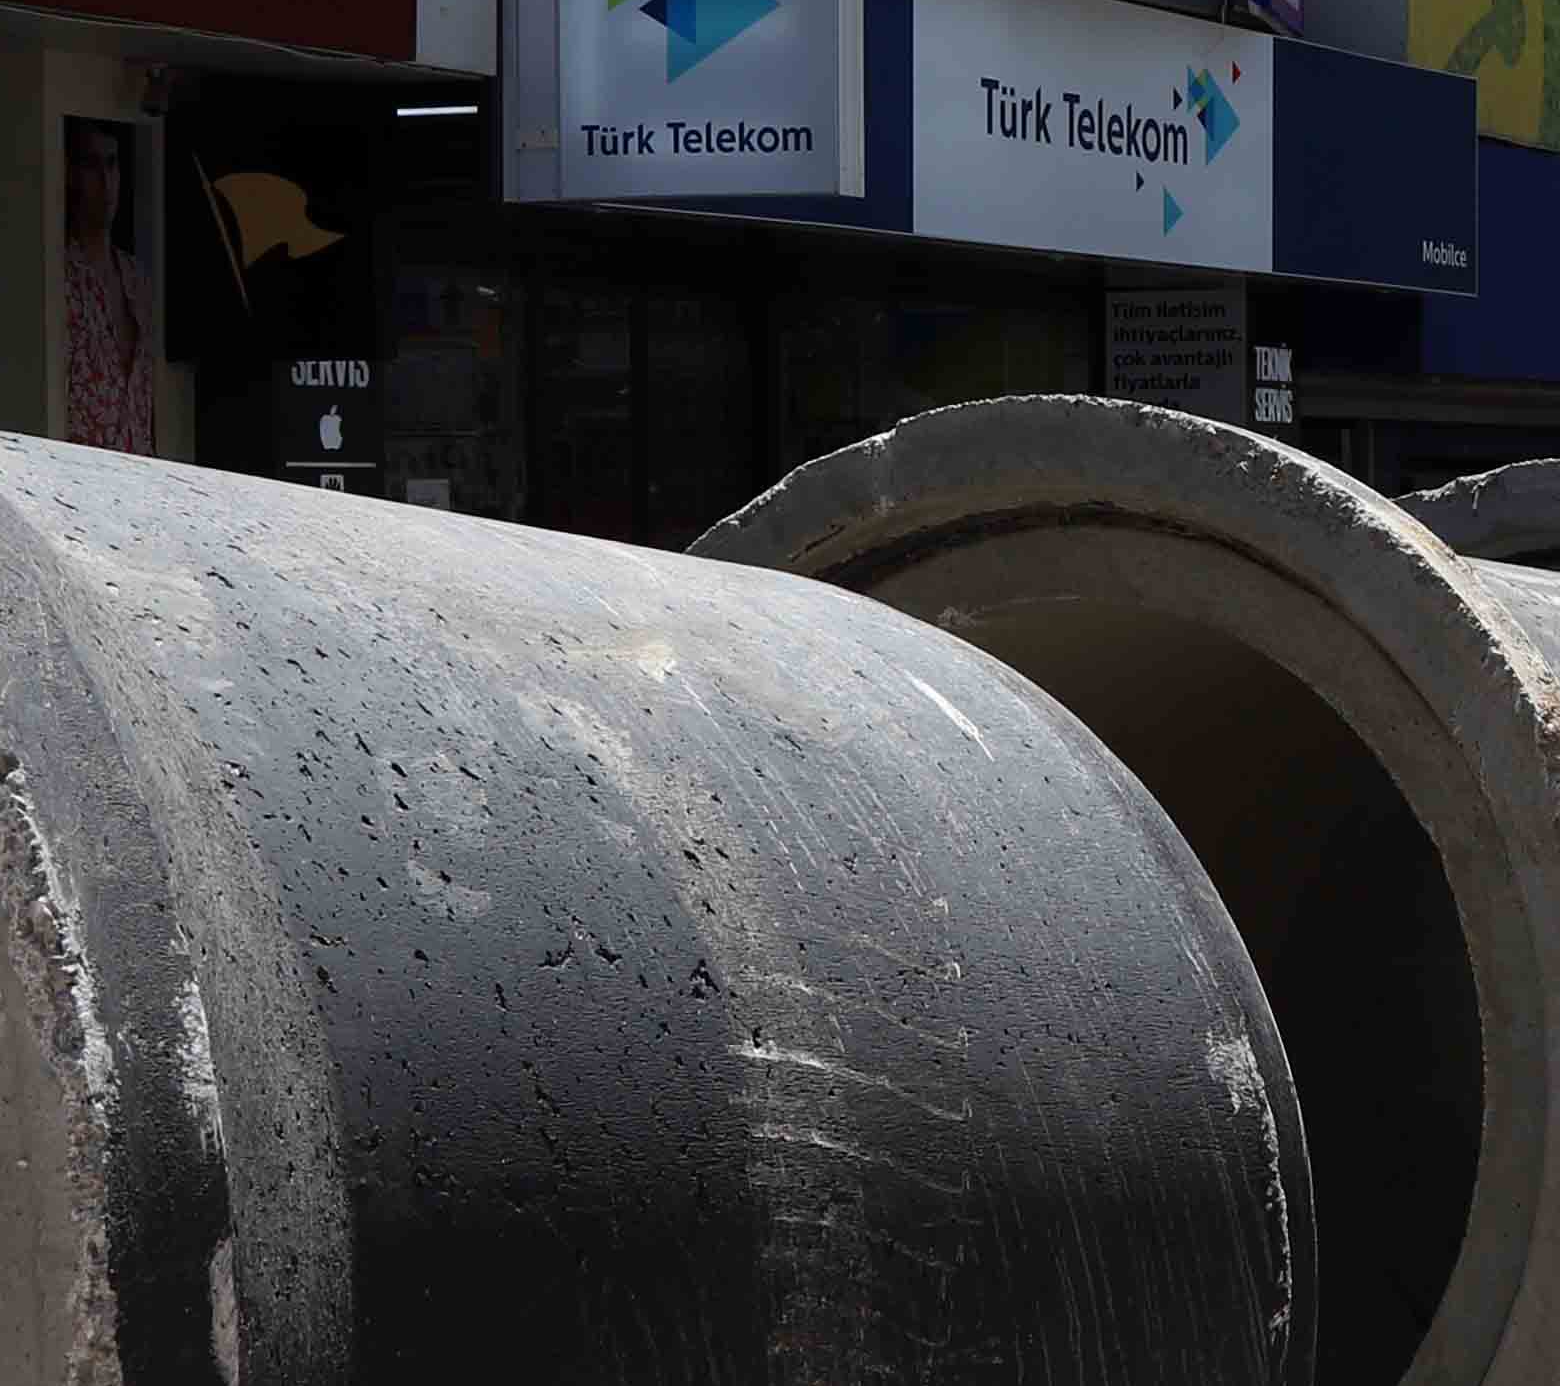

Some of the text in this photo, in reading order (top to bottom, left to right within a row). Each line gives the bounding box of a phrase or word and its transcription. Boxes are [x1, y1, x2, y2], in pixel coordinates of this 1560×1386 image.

[581, 119, 814, 156] Türk Telekom
[980, 76, 1189, 166] Türk Telekom
[1422, 238, 1468, 269] Mobilce
